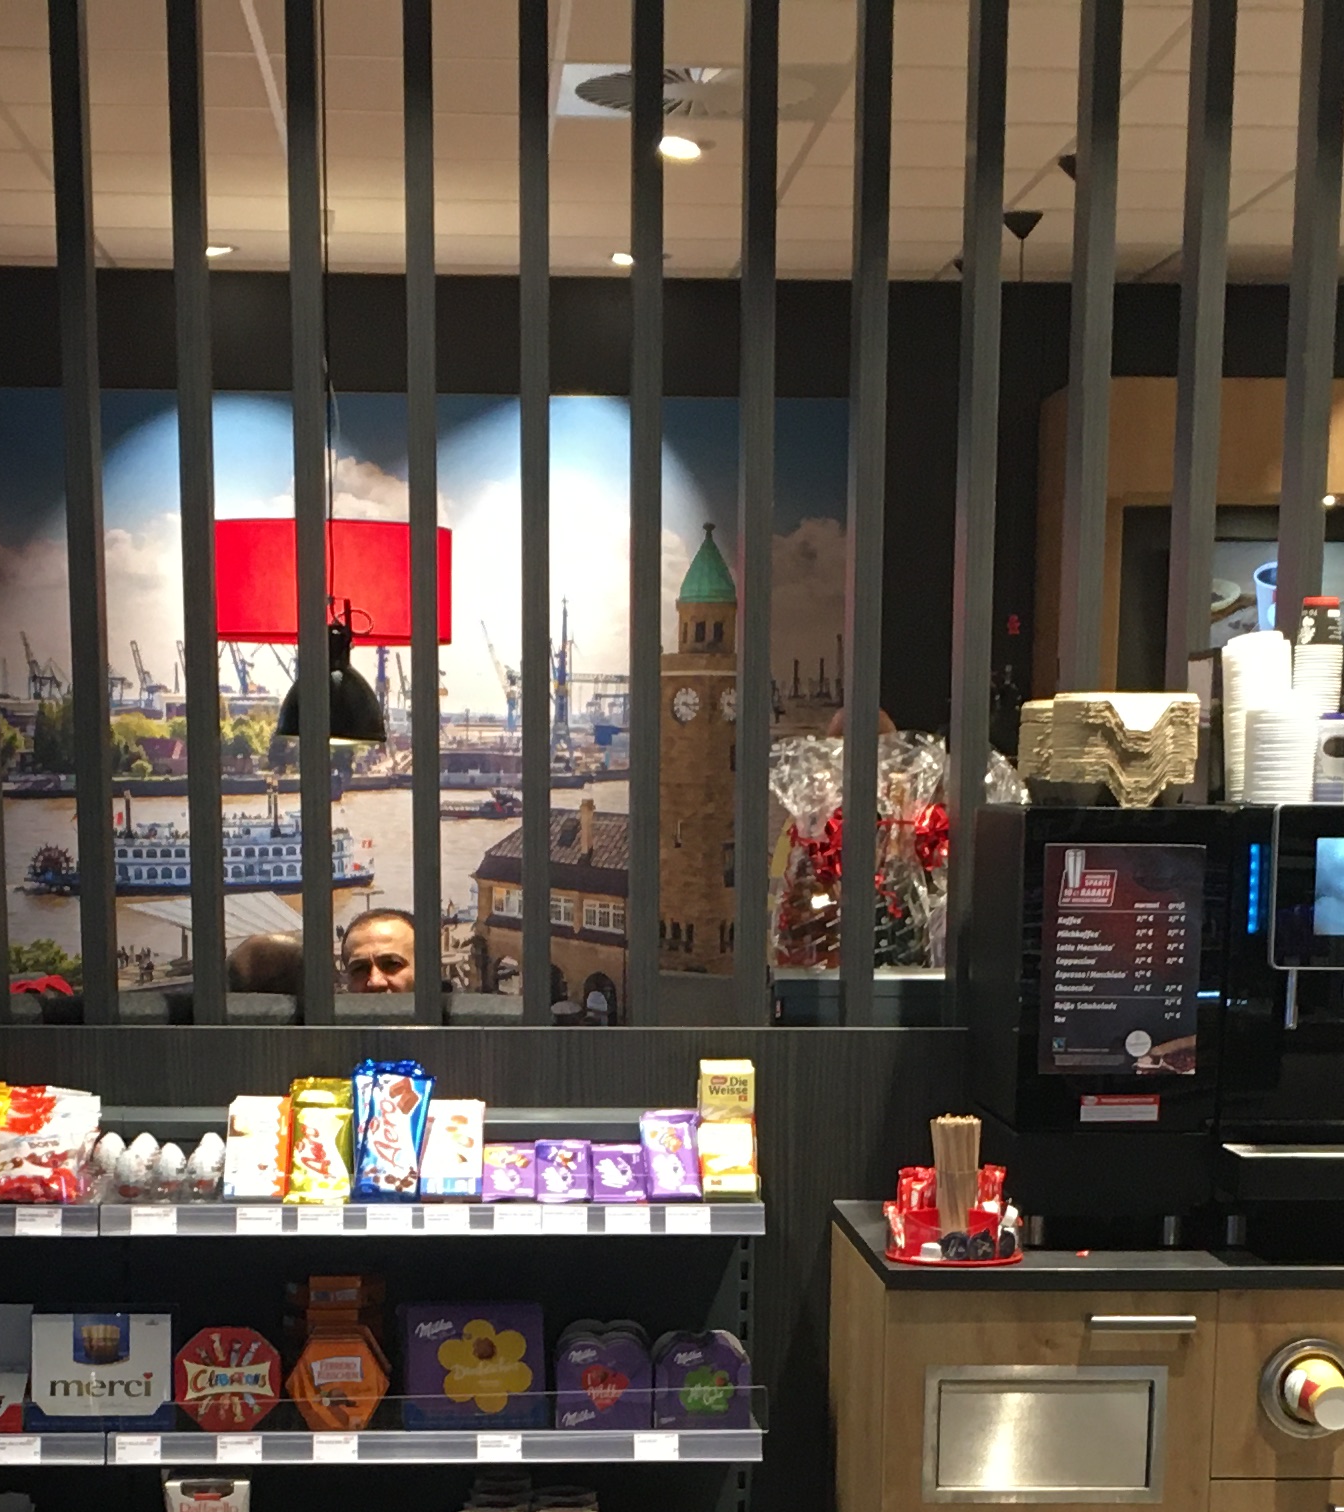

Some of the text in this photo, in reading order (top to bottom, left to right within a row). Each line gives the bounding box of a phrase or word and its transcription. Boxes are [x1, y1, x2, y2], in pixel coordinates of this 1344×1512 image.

[709, 1084, 749, 1095] Weisse
[729, 1076, 748, 1087] Die
[414, 1318, 454, 1339] Milka
[50, 1372, 153, 1397] merci
[561, 1408, 597, 1427] Milka
